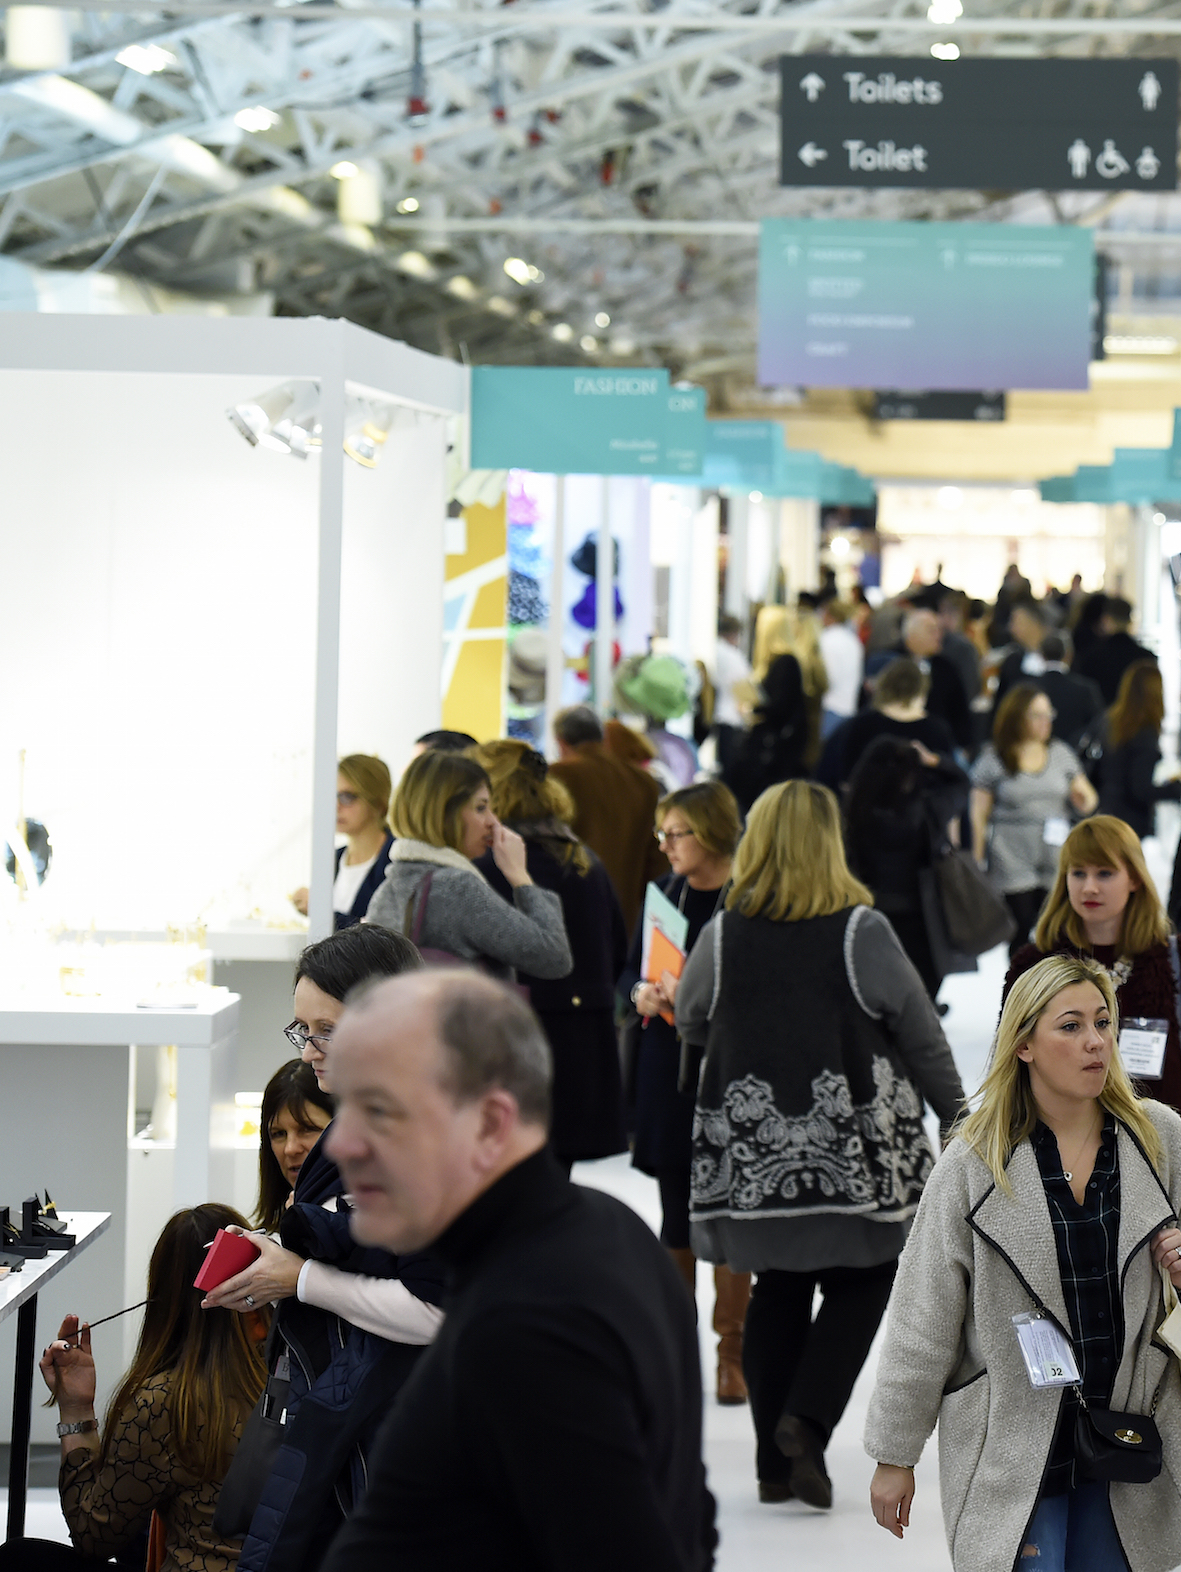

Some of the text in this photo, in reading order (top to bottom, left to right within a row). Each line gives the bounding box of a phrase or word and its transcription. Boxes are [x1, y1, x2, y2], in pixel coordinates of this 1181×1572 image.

[842, 72, 944, 104] Toilets
[842, 139, 928, 171] Toilet
[574, 377, 658, 396] FASHION
